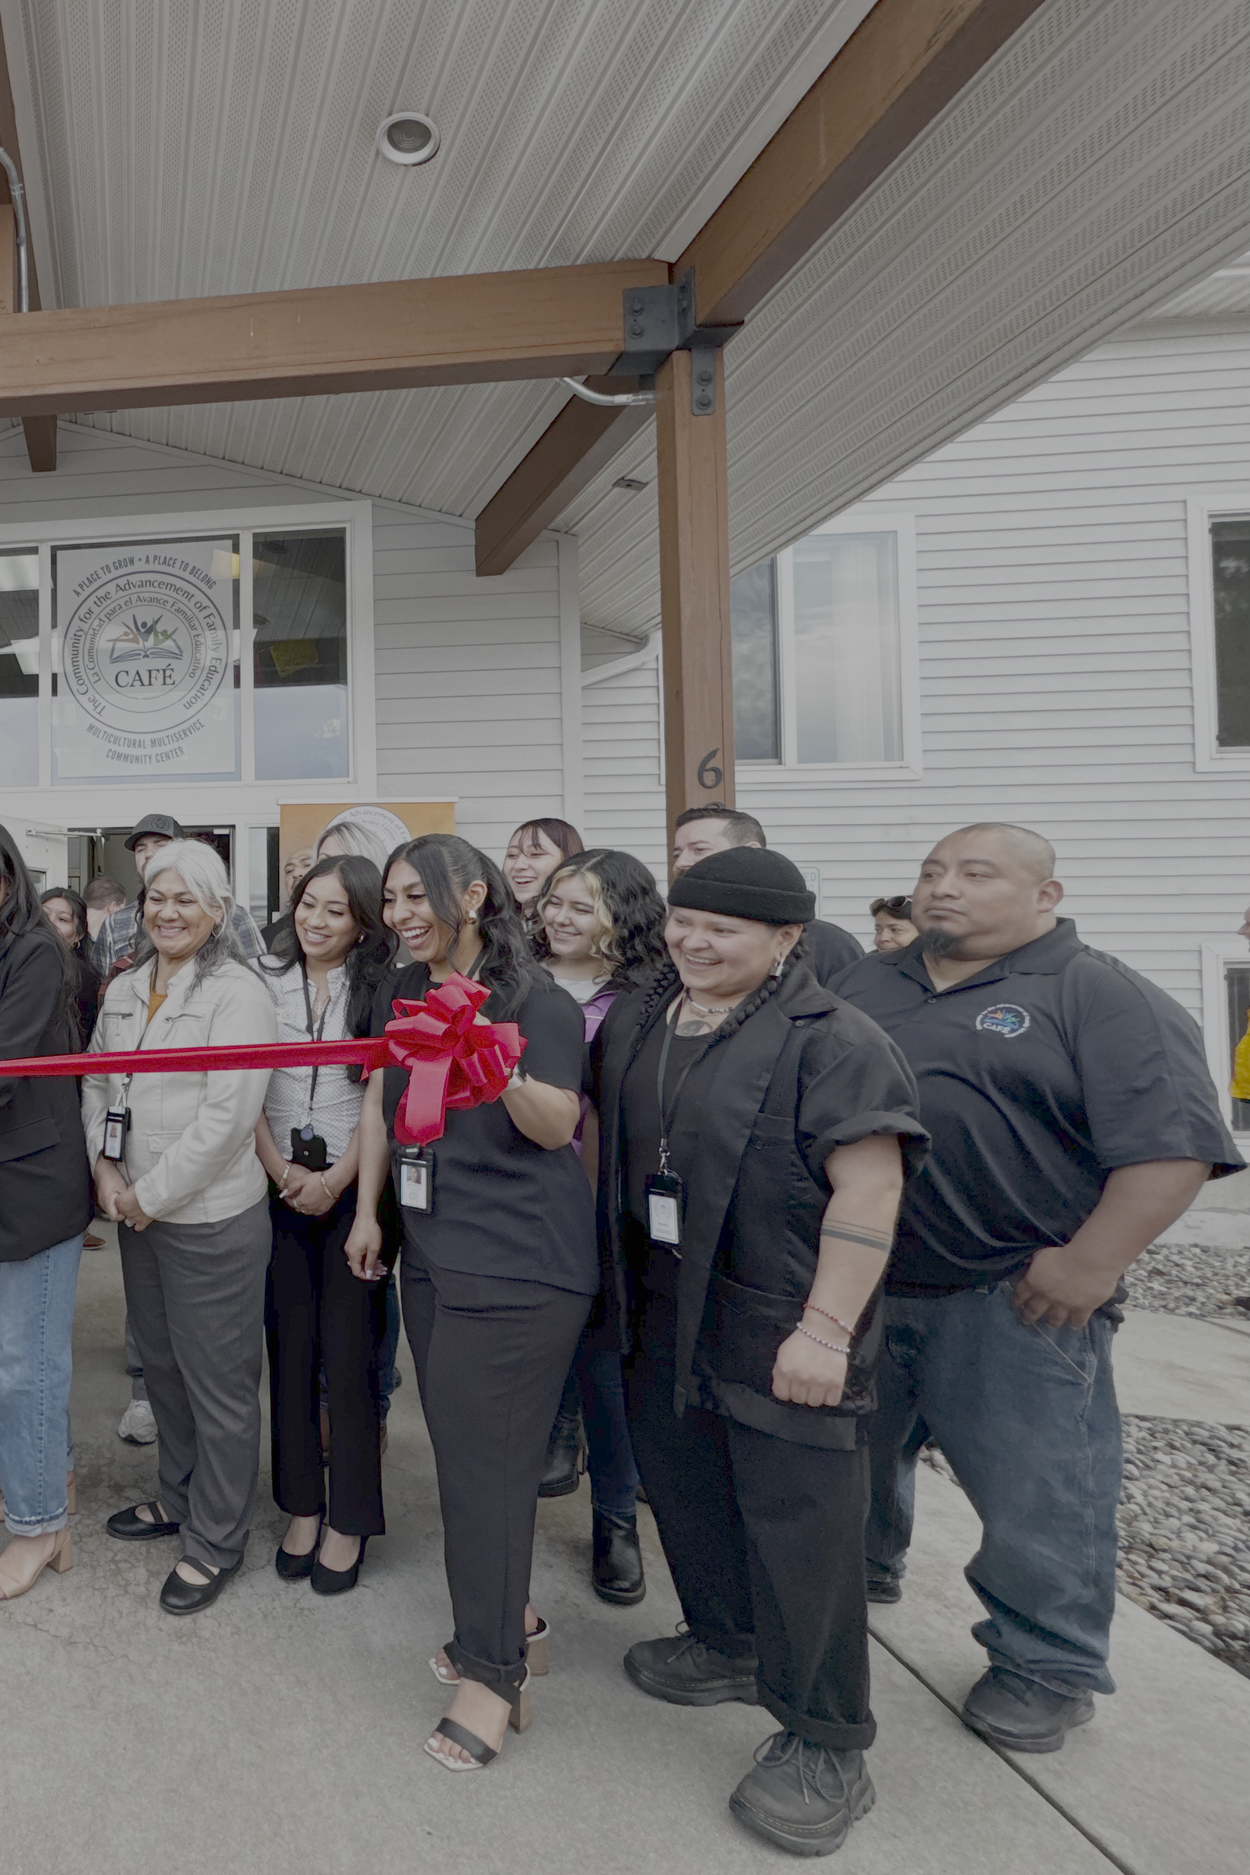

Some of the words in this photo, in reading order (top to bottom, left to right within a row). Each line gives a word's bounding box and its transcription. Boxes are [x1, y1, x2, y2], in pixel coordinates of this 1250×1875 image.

[72, 588, 82, 598] A
[78, 570, 102, 592] PLACE
[100, 564, 112, 576] TO
[112, 556, 135, 571] GROW
[144, 554, 150, 565] A
[152, 554, 178, 569] PLACE
[178, 560, 190, 573] TO
[188, 565, 217, 590] BELONG
[93, 591, 113, 608] the
[115, 578, 195, 602] Advancement
[123, 596, 133, 607] el
[135, 595, 169, 607] Avance
[78, 606, 94, 624] for
[104, 603, 123, 622] para
[170, 600, 198, 632] Familiar
[193, 600, 211, 613] of
[86, 617, 106, 671] Comunidad
[203, 612, 223, 653] Family
[70, 625, 89, 695] Community
[188, 633, 204, 679] Educativo
[91, 671, 101, 684] La
[114, 663, 176, 688] CAFÉ
[183, 657, 222, 710] Education
[87, 694, 106, 717] The
[86, 723, 147, 749] MULTICULTURAL
[150, 719, 205, 748] MULTISERVICE
[106, 748, 152, 765] COMMUNITY
[155, 746, 186, 764] CENTER
